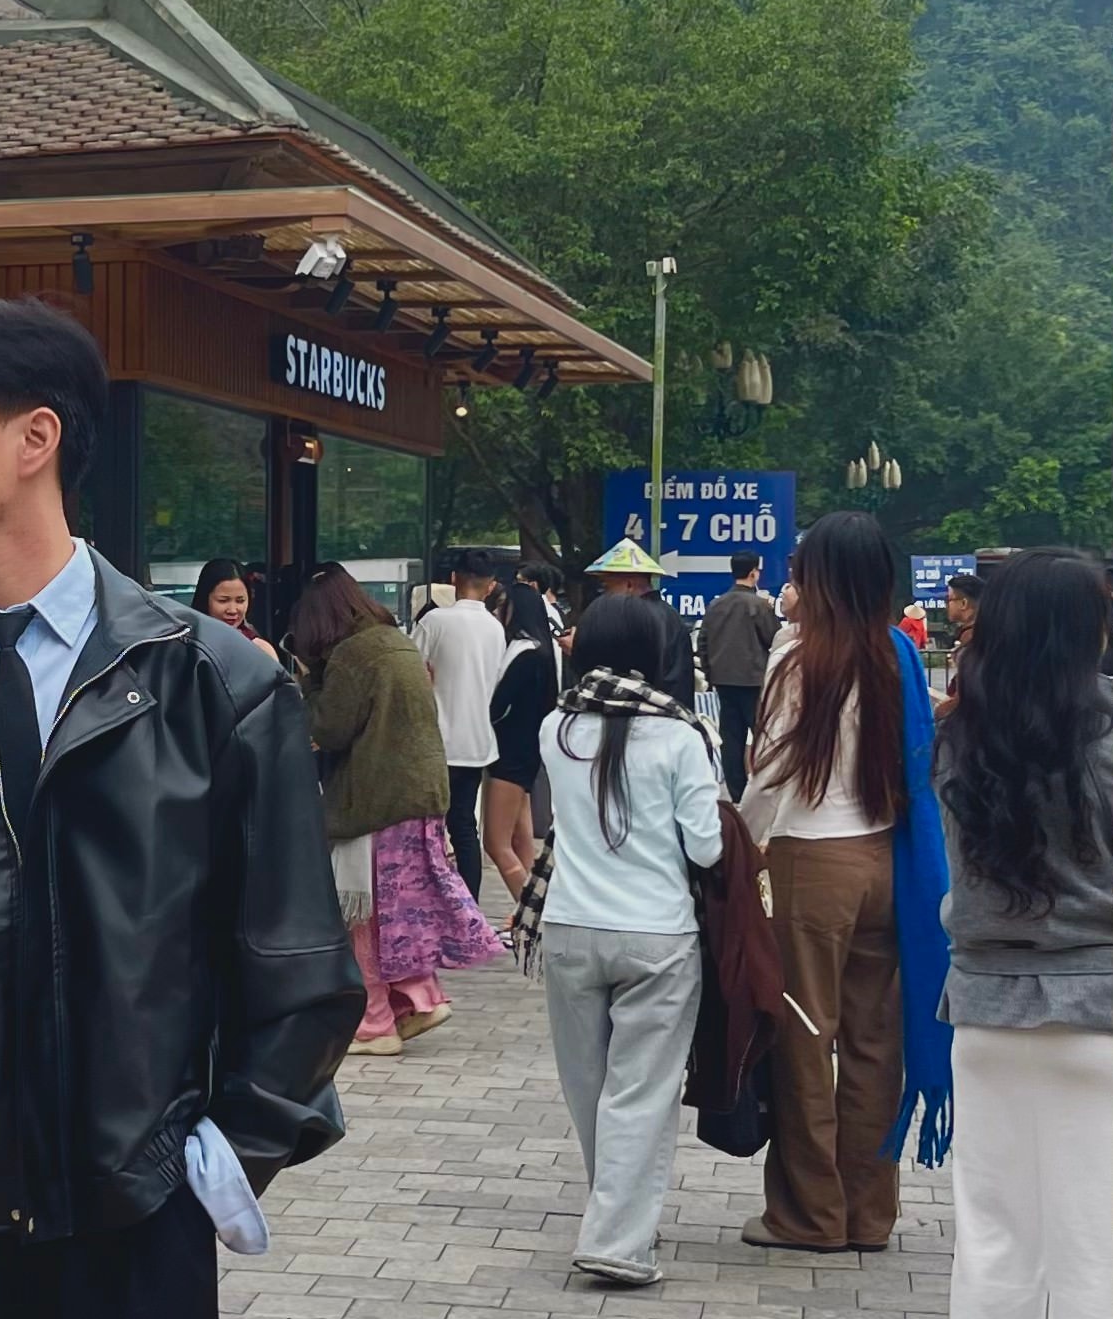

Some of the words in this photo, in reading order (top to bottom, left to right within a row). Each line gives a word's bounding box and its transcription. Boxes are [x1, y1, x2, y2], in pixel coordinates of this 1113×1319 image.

[286, 334, 385, 411] STARBUCKS
[700, 476, 727, 500] ĐỖ
[733, 482, 758, 500] XE
[624, 513, 644, 540] 4
[678, 514, 699, 541] 7
[710, 503, 776, 542] CHỖ
[679, 594, 706, 616] RA
